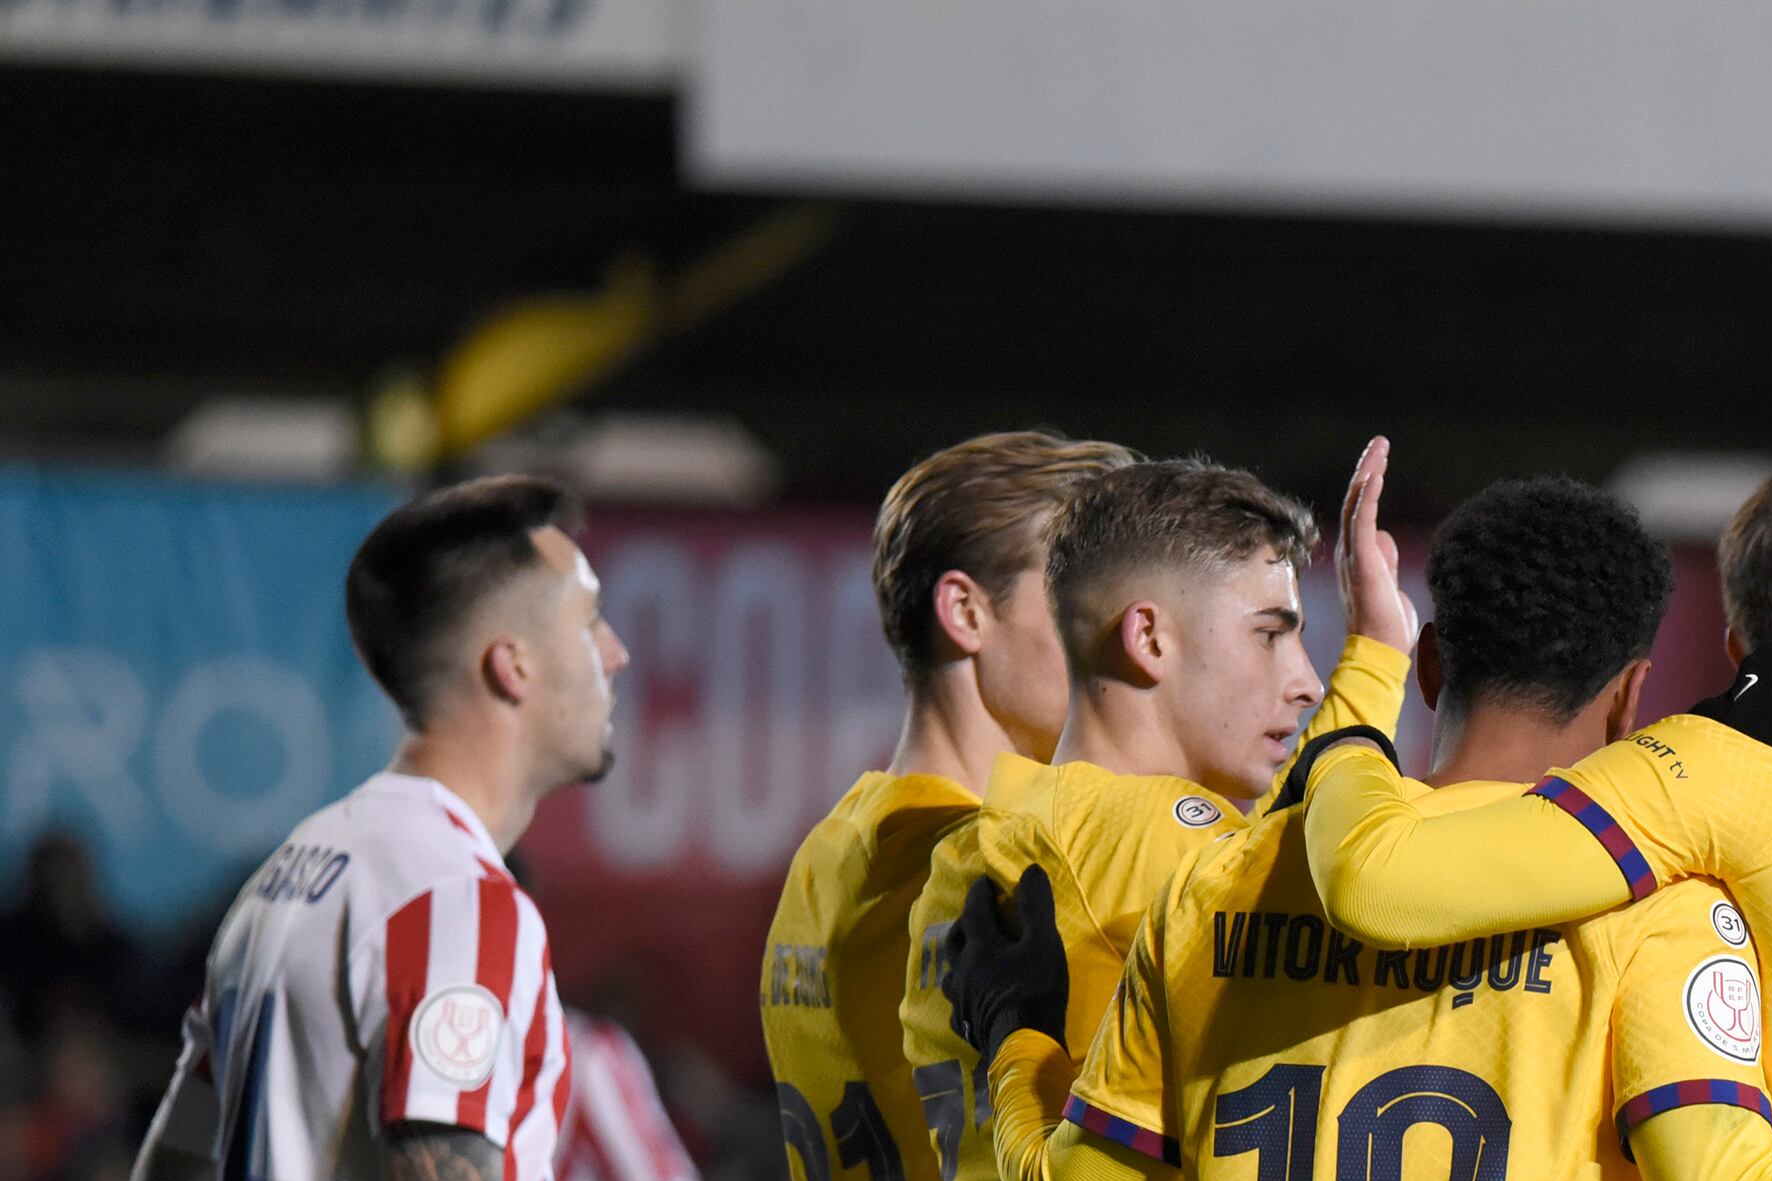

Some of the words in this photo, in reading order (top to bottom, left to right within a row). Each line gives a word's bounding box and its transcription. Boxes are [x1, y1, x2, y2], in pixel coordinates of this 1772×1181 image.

[1721, 915, 1741, 932] 31
[1213, 911, 1360, 986] VITOR
[1374, 928, 1562, 1010] ROQUE
